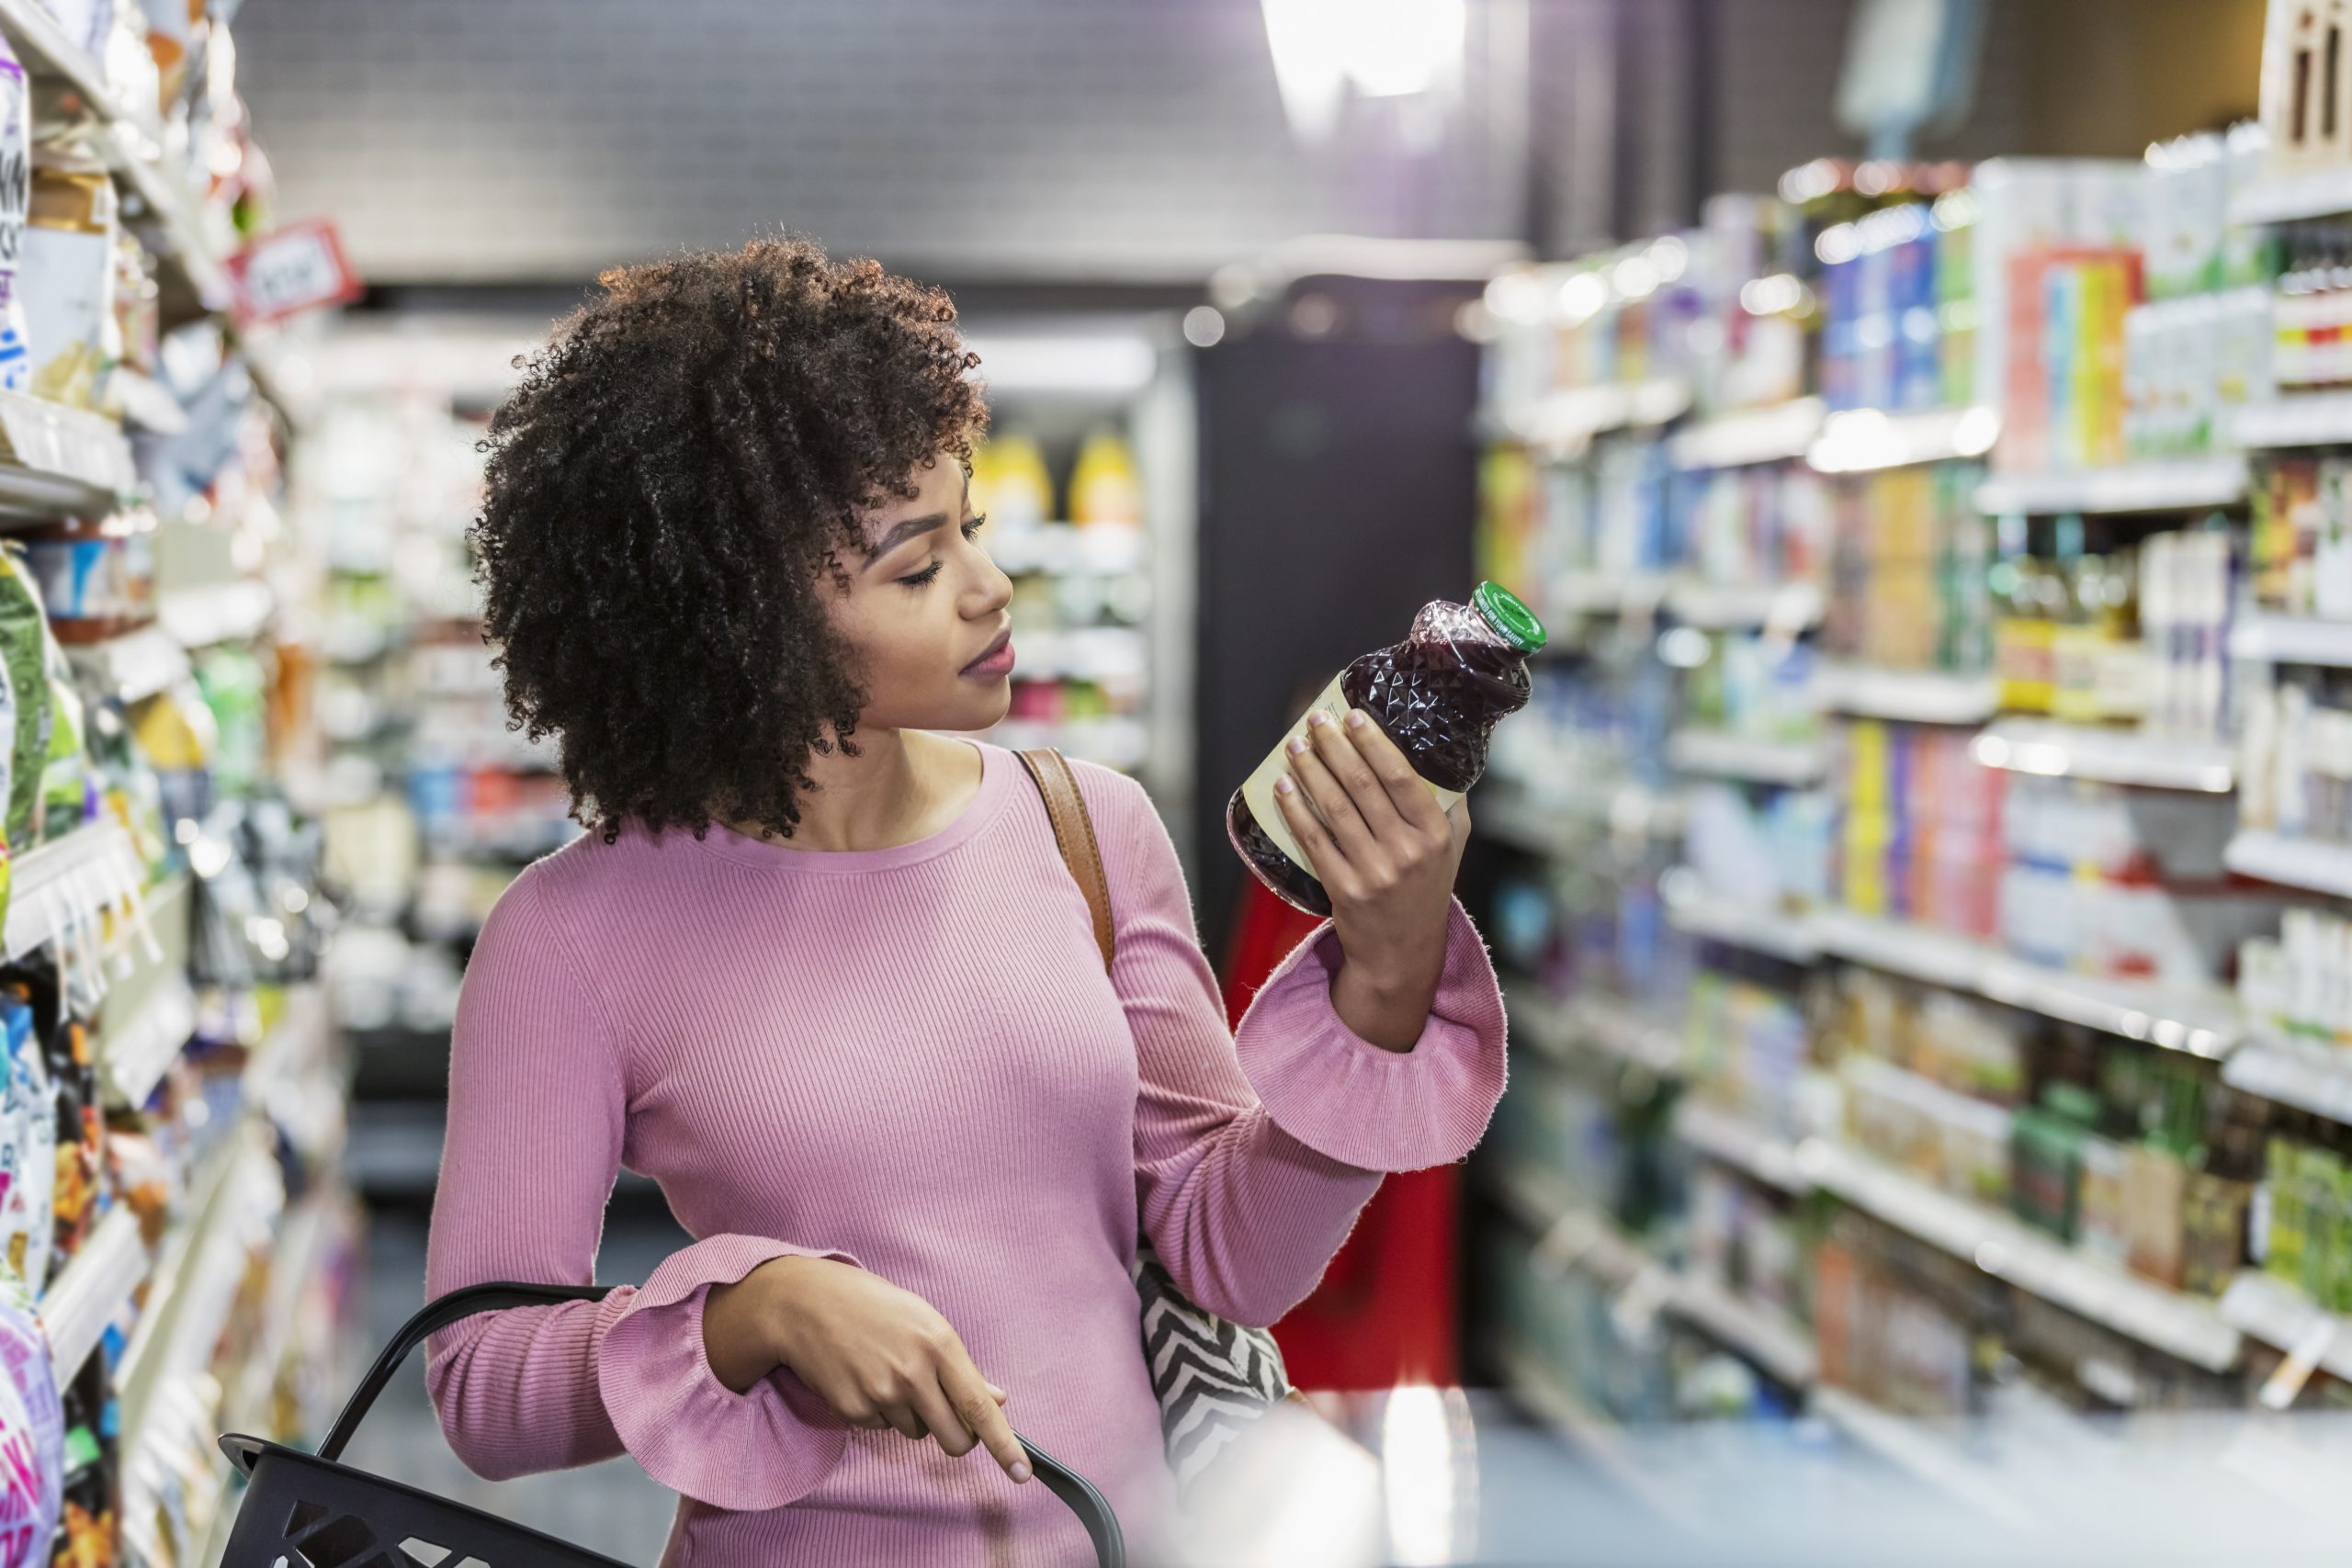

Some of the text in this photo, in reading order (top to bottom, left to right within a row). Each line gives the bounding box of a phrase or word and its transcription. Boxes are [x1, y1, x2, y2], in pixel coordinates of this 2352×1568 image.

[1487, 610, 1498, 623] FOR
[1494, 617, 1509, 634] YOUR
[1505, 629, 1525, 647] SAFETY
